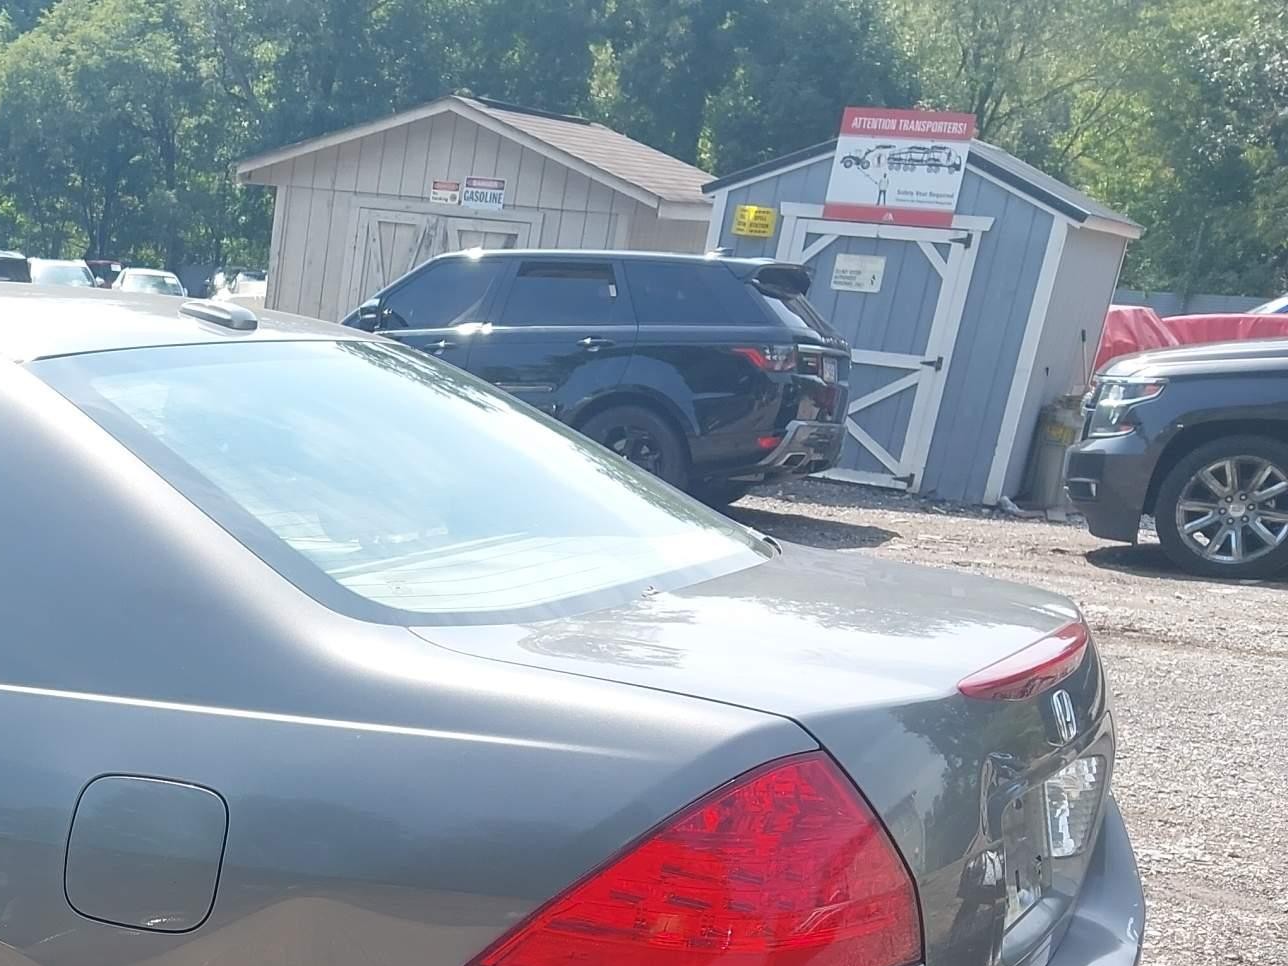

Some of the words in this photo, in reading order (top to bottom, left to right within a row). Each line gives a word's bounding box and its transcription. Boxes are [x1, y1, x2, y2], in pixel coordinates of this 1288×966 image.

[851, 117, 897, 131] ATTENTION
[898, 119, 968, 135] TRANSPORTERS!
[463, 190, 503, 204] GASOLINE
